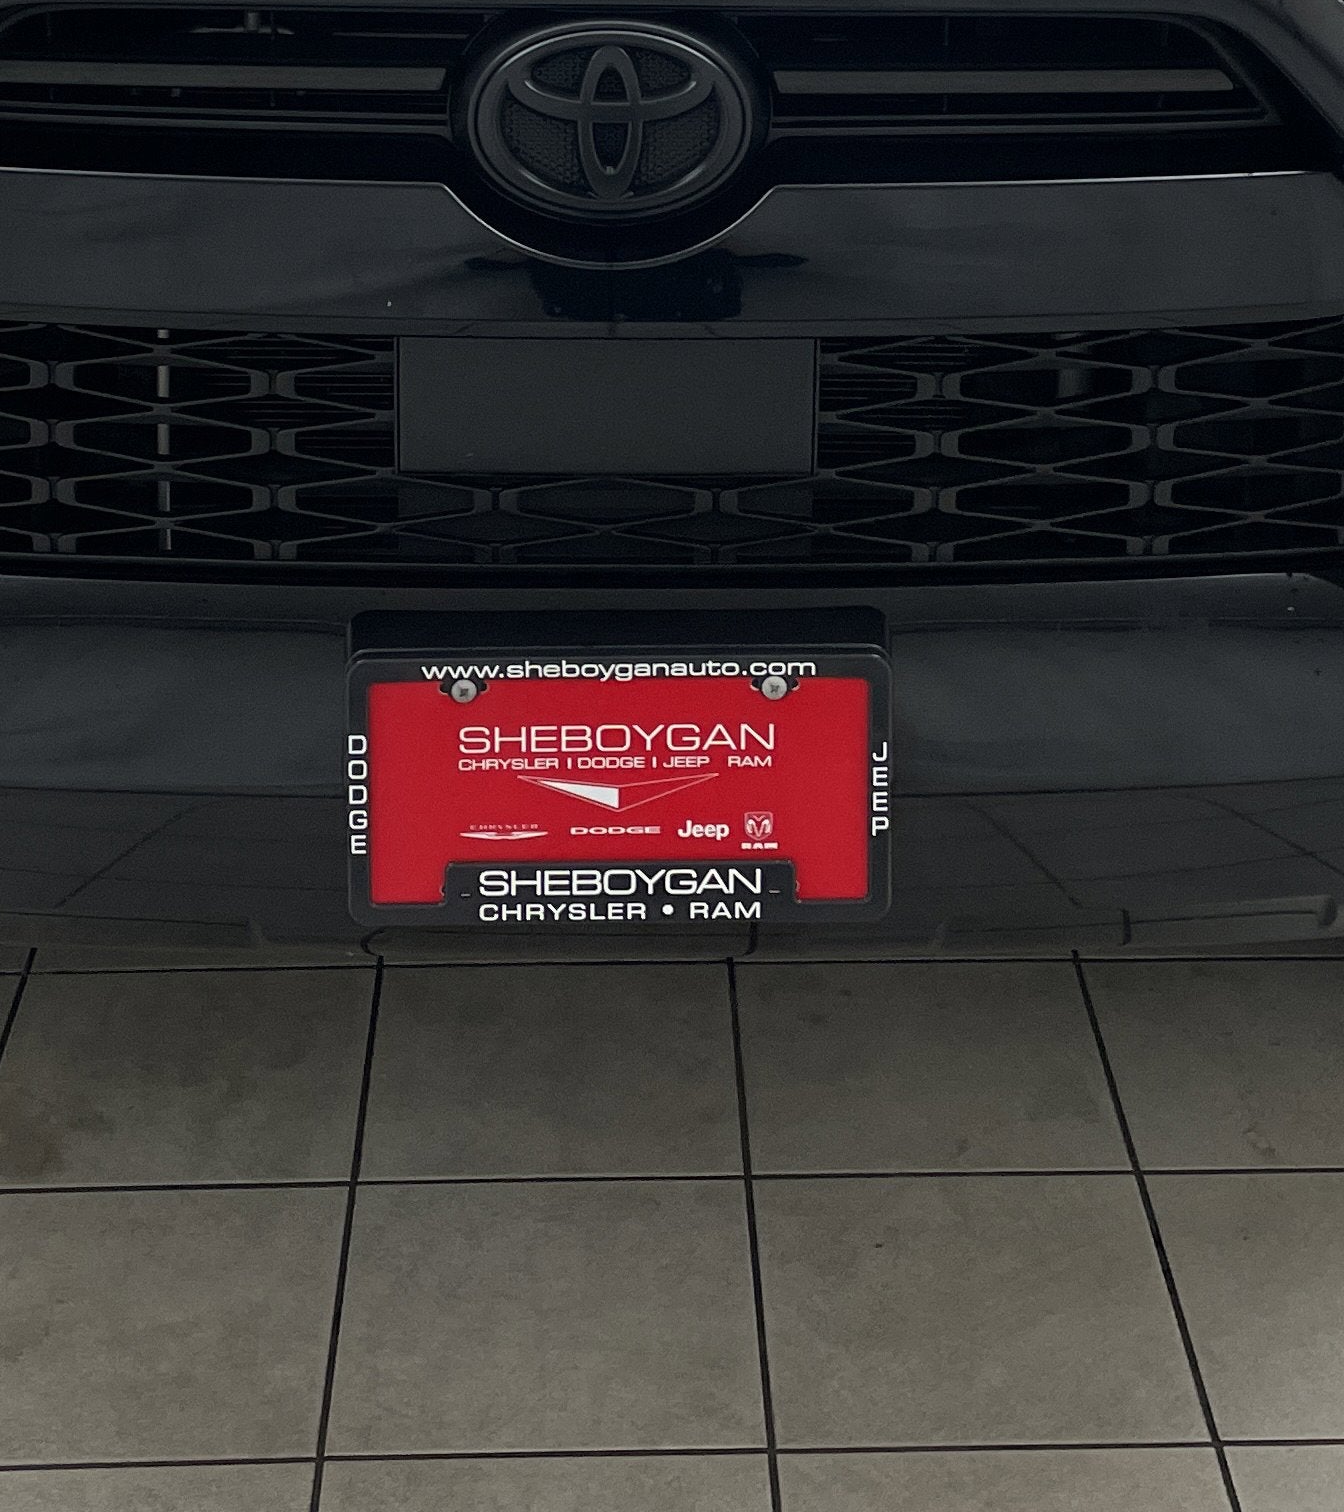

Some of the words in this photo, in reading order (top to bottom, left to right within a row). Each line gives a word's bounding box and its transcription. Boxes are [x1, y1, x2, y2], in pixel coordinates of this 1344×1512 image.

[421, 660, 817, 682] www.sheboyganauto.com
[458, 723, 775, 754] SHEBOYGAN
[458, 758, 559, 771] CHRYSLER
[578, 757, 645, 769] DODGE
[663, 756, 710, 768] JEEP
[727, 756, 773, 767] RAM
[347, 734, 368, 855] DODGE
[871, 741, 889, 837] JEEP
[570, 826, 661, 835] DODGE
[678, 820, 730, 840] Jeep
[478, 868, 762, 896] SHEBOYGAN
[478, 903, 647, 921] CHRYSLER
[689, 901, 761, 919] RAM
